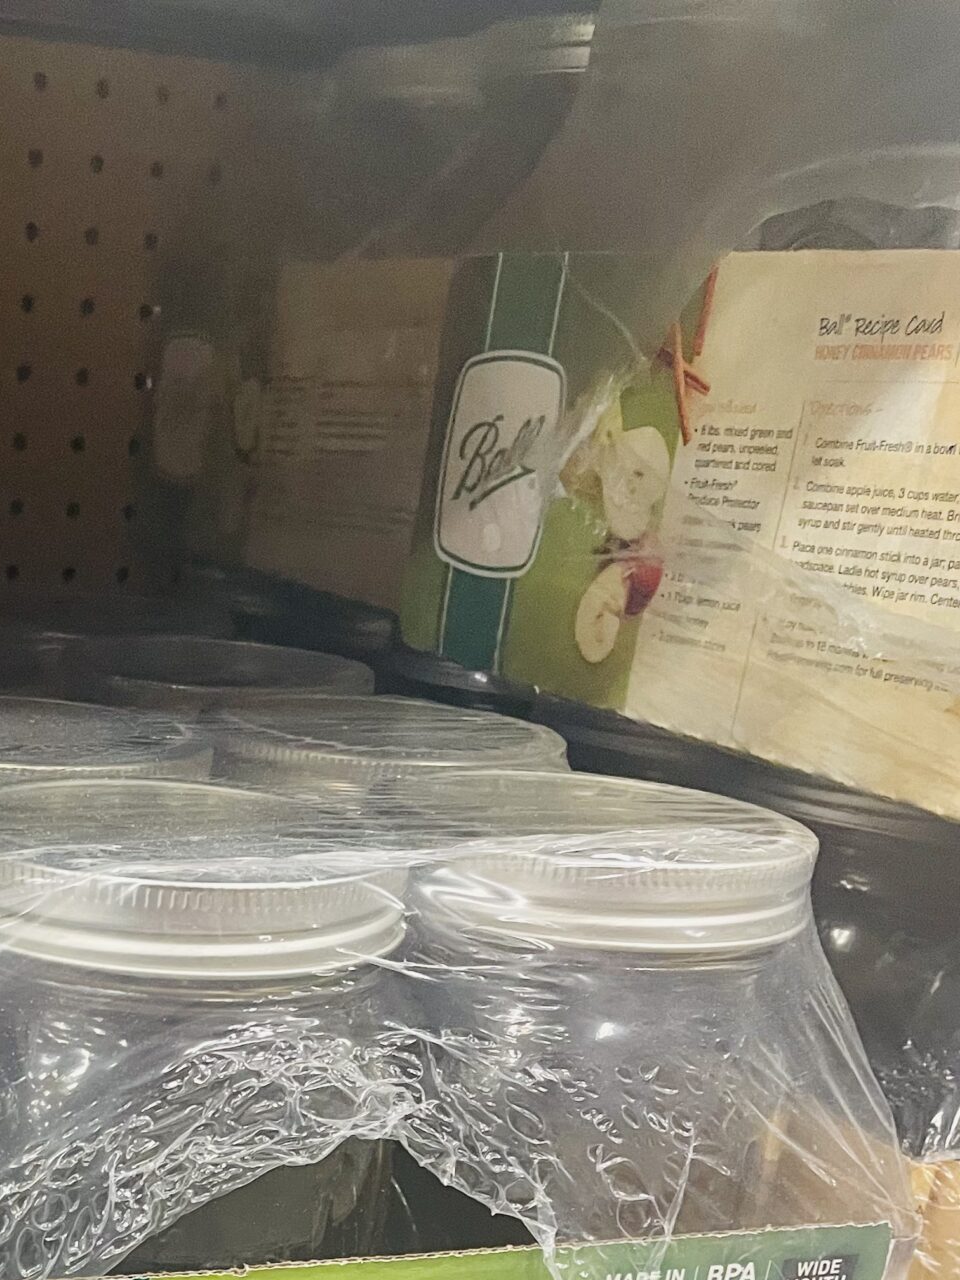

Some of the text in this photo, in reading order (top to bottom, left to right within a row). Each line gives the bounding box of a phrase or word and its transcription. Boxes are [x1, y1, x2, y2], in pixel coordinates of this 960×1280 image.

[854, 314, 901, 343] Recipe
[905, 310, 946, 336] Card
[912, 344, 952, 360] PEARS
[815, 437, 854, 450] Combine
[915, 441, 924, 451] in
[451, 414, 546, 512] Ball
[806, 480, 845, 495] Combine
[845, 486, 872, 501] apple
[871, 485, 896, 500] juice,
[897, 487, 906, 499] 3
[906, 489, 930, 502] cups
[802, 501, 844, 513] saucepan
[845, 502, 860, 514] set
[860, 504, 882, 515] over
[881, 505, 920, 518] medium
[798, 517, 823, 530] syrup
[822, 518, 841, 530] and
[841, 520, 857, 532] stir
[856, 521, 886, 537] gently
[886, 524, 909, 536] until
[908, 526, 941, 540] heated
[792, 540, 816, 554] Place
[816, 544, 834, 557] one
[834, 545, 878, 561] cinnamon
[878, 550, 902, 564] stick
[903, 553, 922, 567] into
[922, 556, 929, 567] a
[792, 560, 836, 574] adspace.
[837, 564, 863, 578] Ladle
[863, 567, 881, 580] hot
[880, 570, 907, 584] syrup
[907, 573, 929, 586] over
[871, 586, 896, 600] Wipe
[895, 589, 909, 604] jar
[909, 591, 928, 604] rim.
[796, 1257, 843, 1277] WIDE
